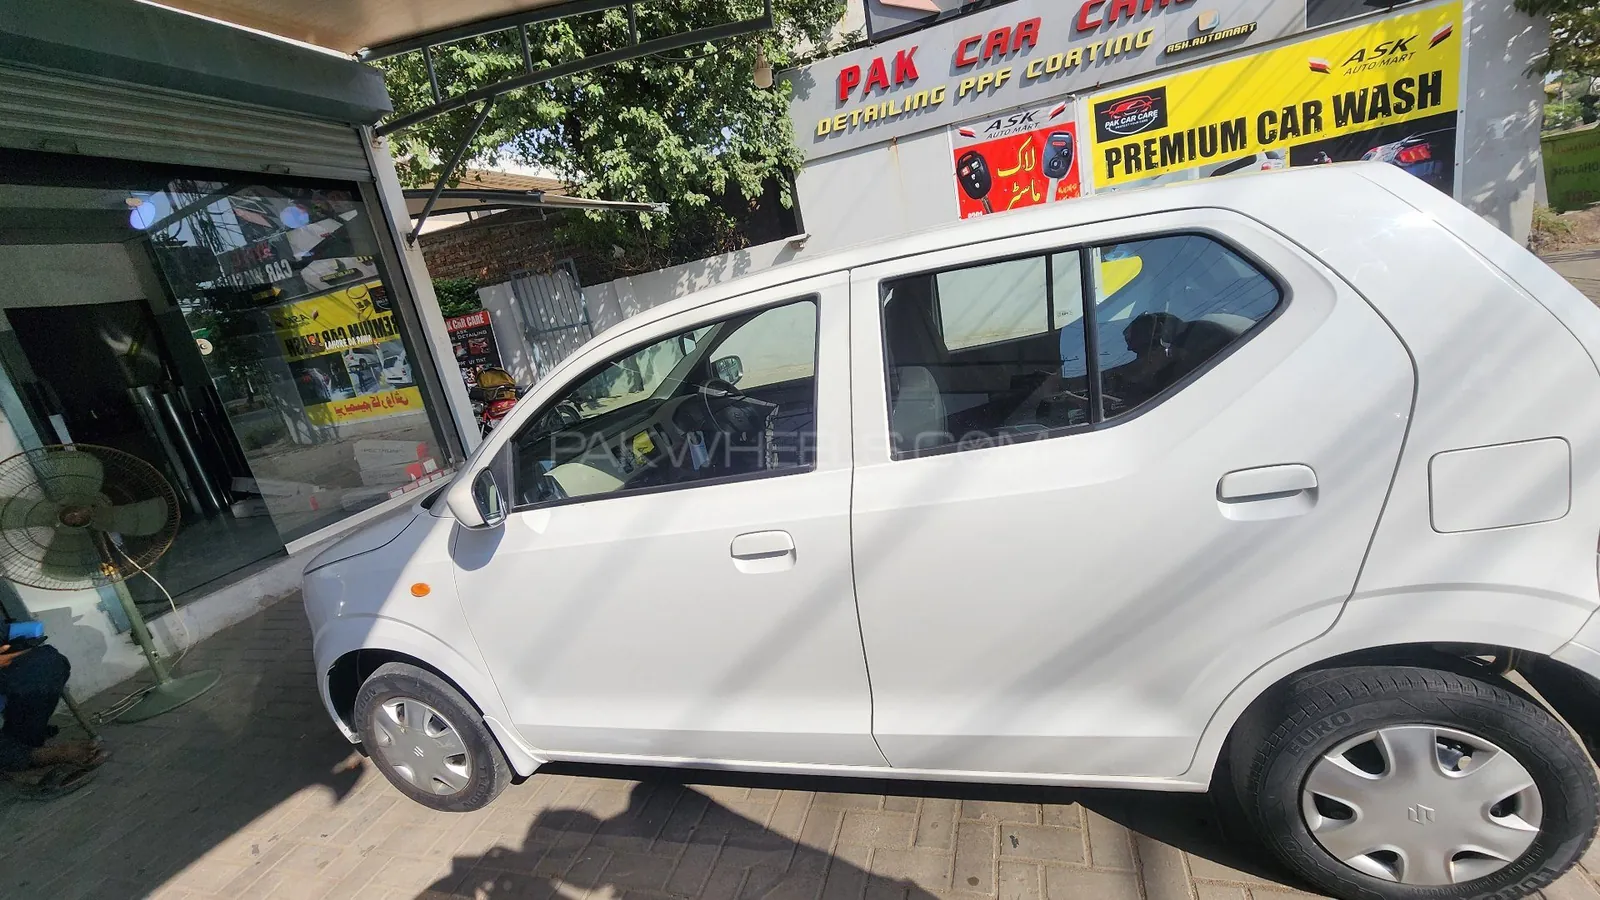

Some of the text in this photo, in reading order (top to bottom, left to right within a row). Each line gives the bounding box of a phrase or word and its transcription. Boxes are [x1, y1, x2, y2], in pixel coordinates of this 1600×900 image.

[840, 0, 1190, 100] PAK CAR CA
[1341, 35, 1418, 67] ASK
[1343, 51, 1417, 76] AUTO MART
[817, 28, 1154, 136] DETAILING PPF COATING
[984, 110, 1040, 133] ASK
[986, 122, 1040, 139] AUTO MART
[1104, 109, 1159, 129] PAK CAR CARE
[1105, 70, 1442, 179] PREMIUM CAR WASH
[997, 135, 1036, 177] لاک
[467, 314, 484, 327] CARE
[1290, 711, 1352, 754] EURO
